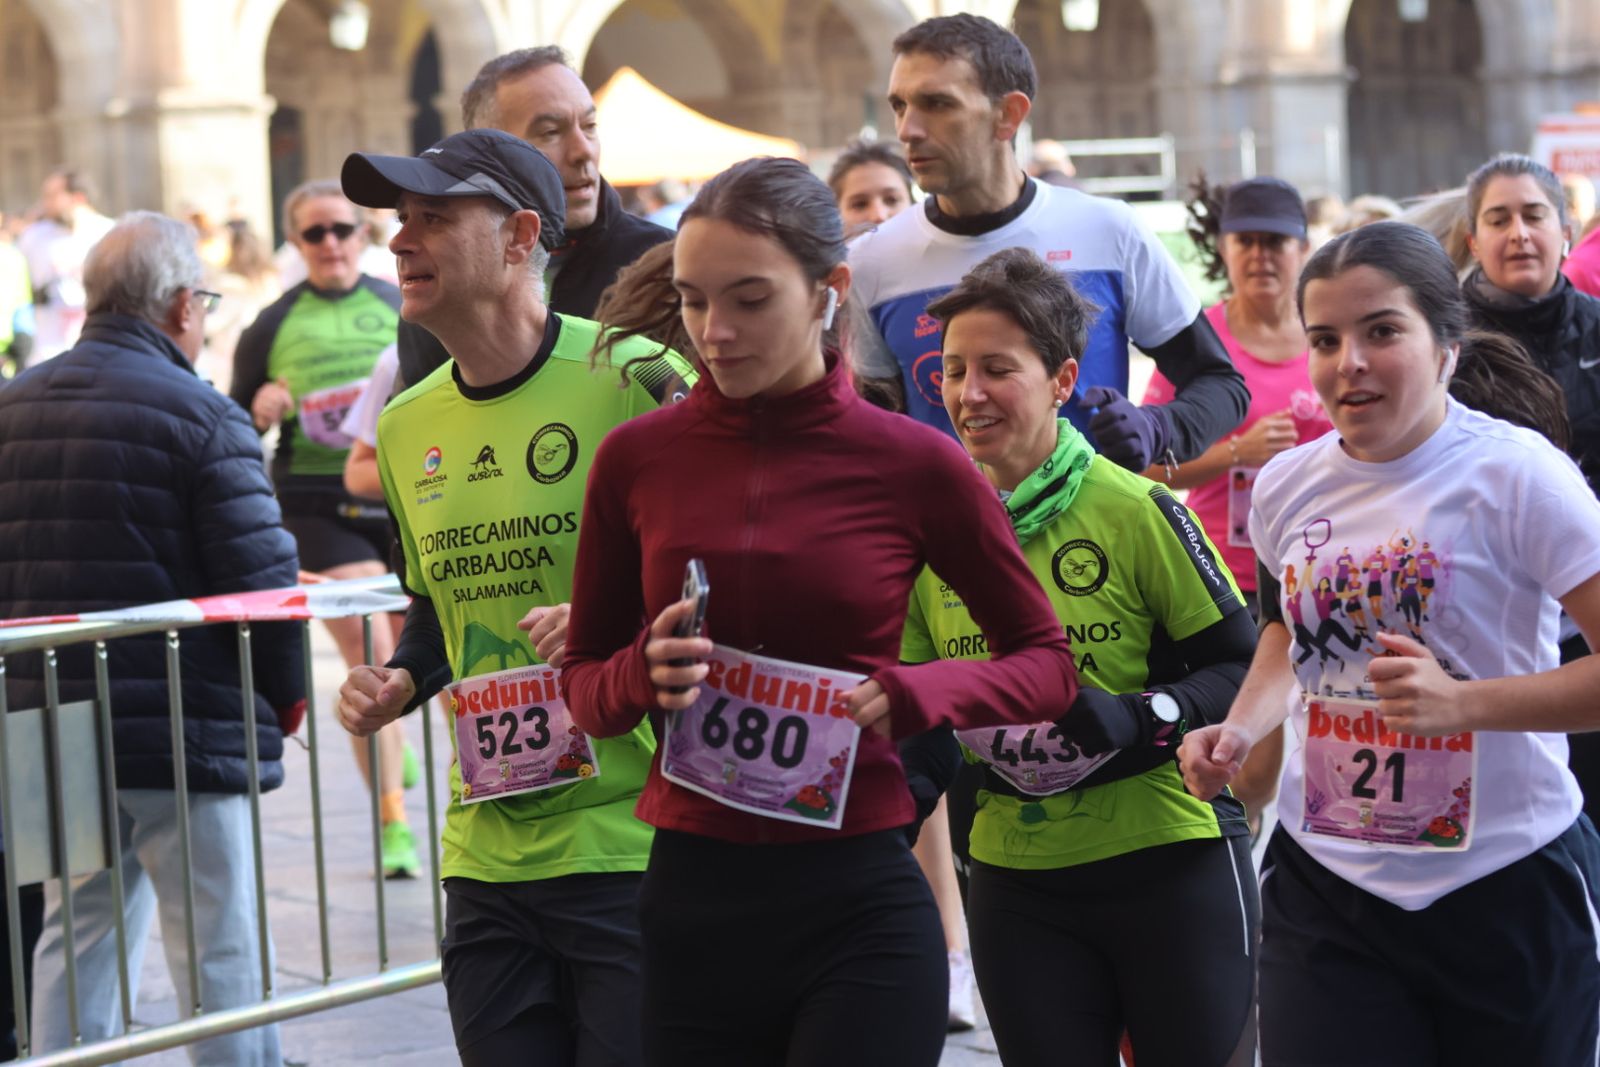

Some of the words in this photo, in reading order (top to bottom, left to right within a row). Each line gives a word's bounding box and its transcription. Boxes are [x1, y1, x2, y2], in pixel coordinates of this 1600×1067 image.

[420, 512, 577, 556] CORRECAMINOS
[431, 546, 555, 582] CARBAJOSA
[453, 579, 543, 603] SALAMANCA
[476, 707, 551, 760] 523
[702, 697, 809, 769] 680
[991, 728, 1079, 767] 443
[1352, 748, 1405, 803] 21
